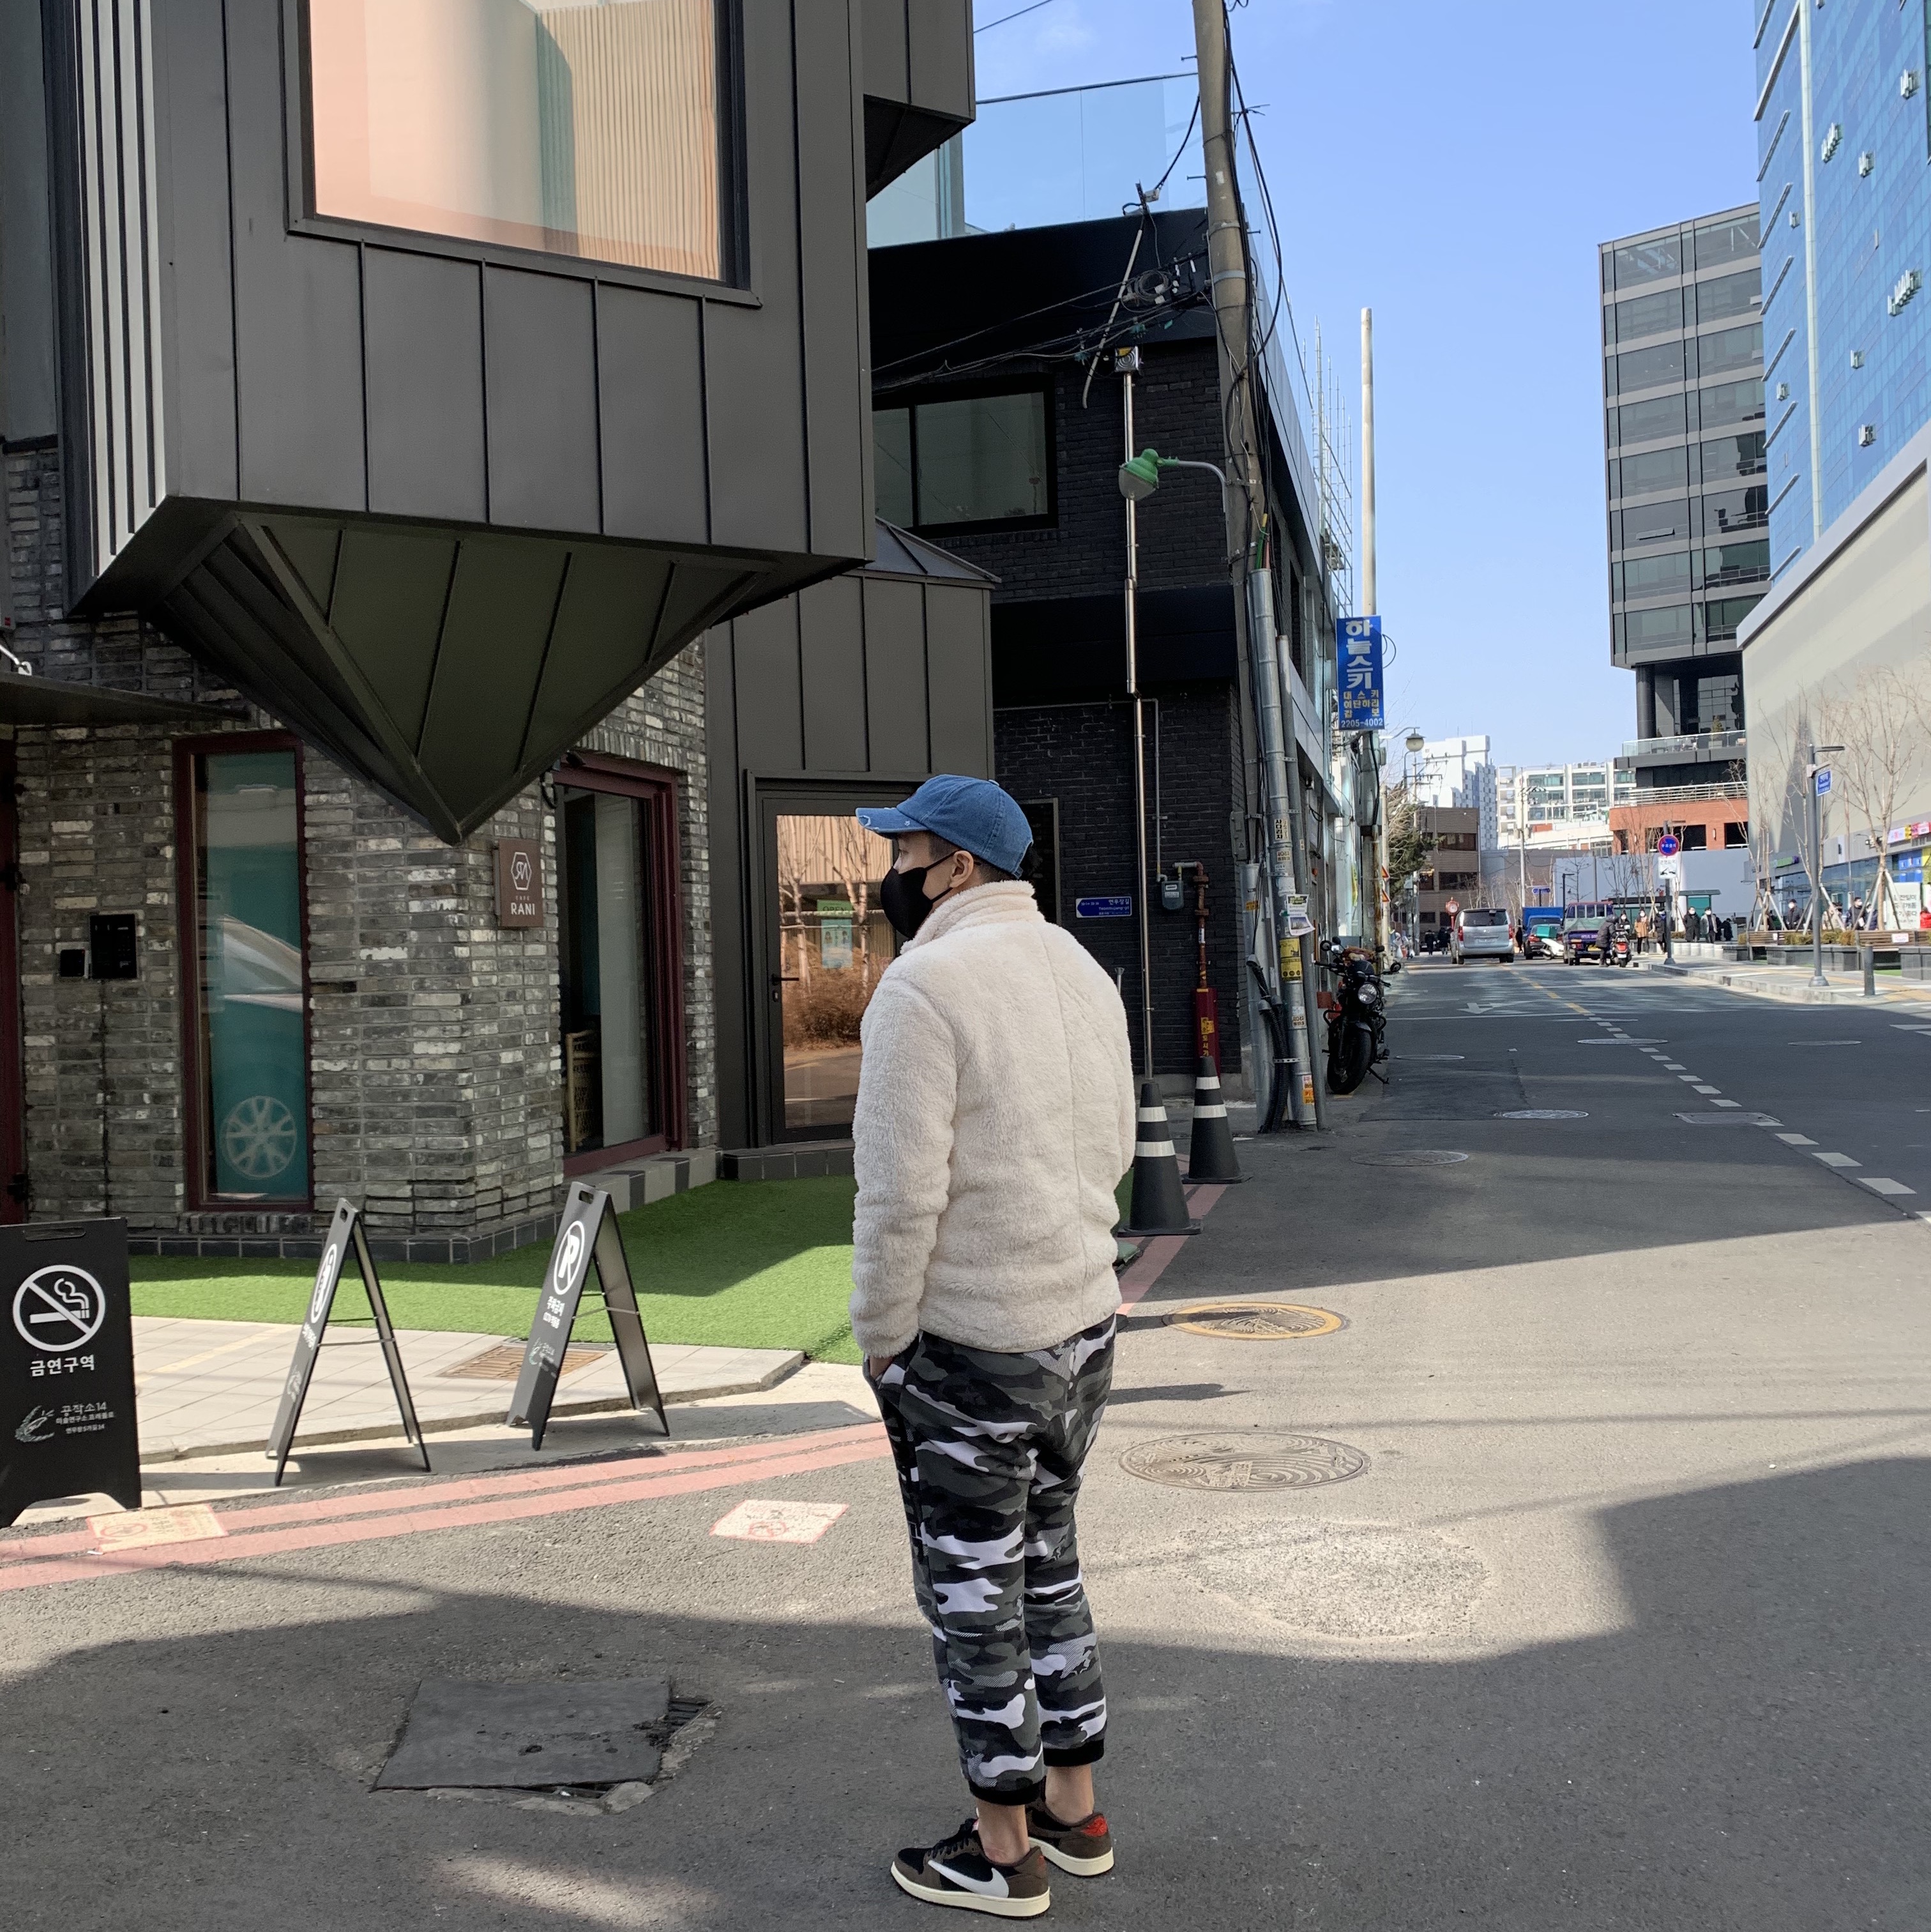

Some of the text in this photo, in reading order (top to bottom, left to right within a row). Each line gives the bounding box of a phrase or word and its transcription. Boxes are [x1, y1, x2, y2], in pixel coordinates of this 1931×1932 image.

[1345, 619, 1374, 689] 하늘스키
[1341, 717, 1383, 728] 2205-4002
[510, 902, 536, 916] RANI
[30, 1354, 95, 1377] 금연구역
